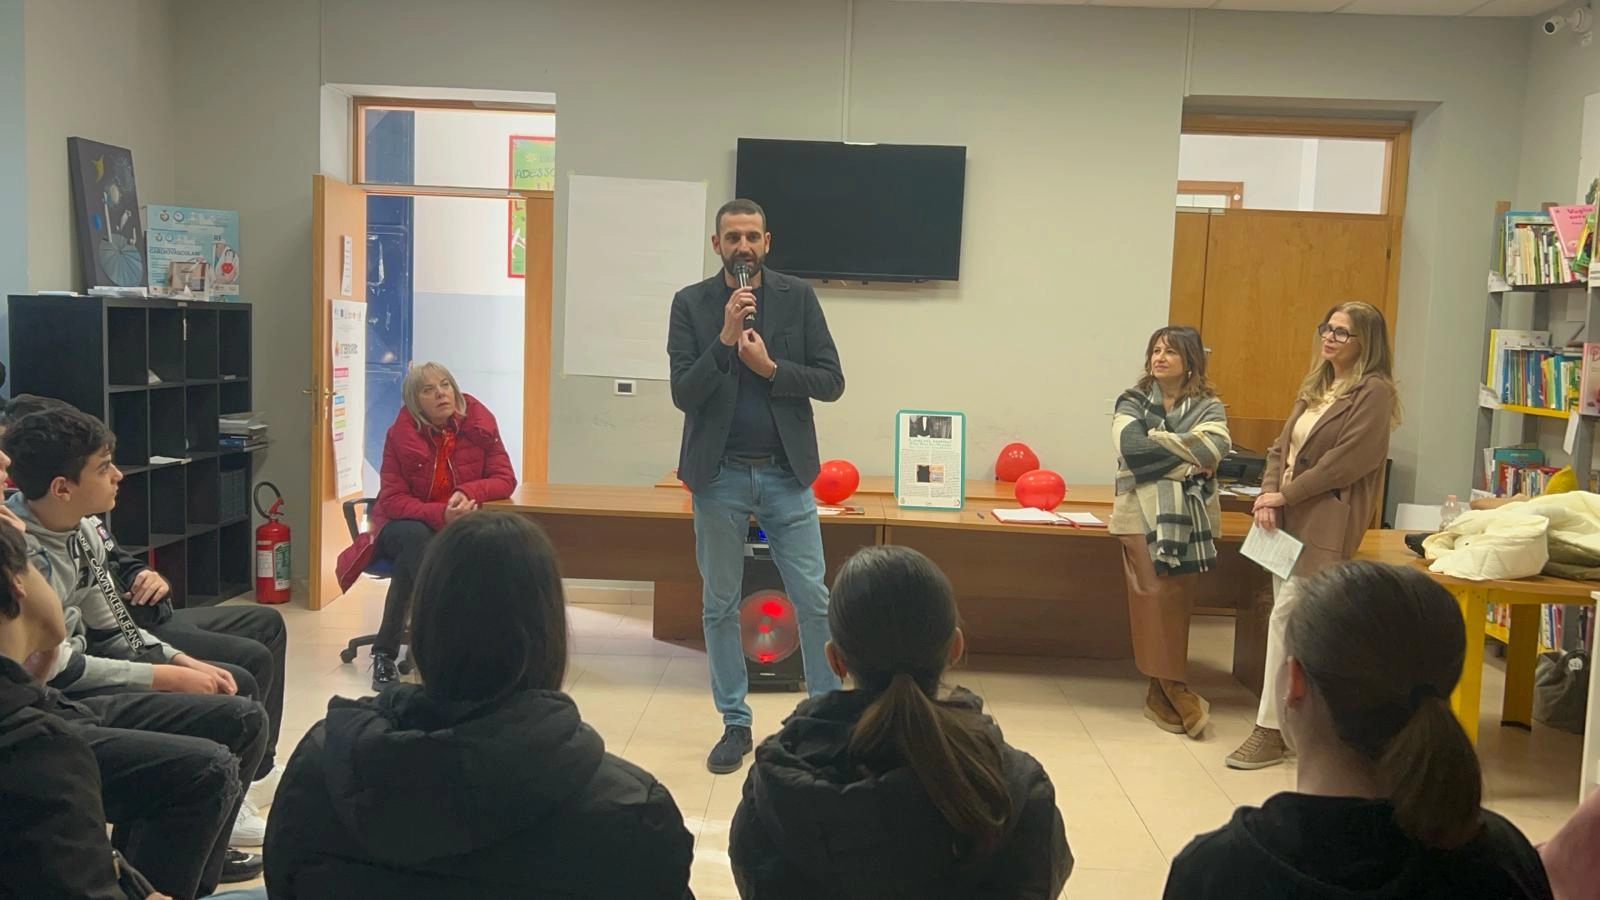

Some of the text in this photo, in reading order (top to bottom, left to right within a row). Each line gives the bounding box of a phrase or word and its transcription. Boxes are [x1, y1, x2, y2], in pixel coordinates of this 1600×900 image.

[90, 558, 111, 592] CALVIN
[106, 592, 125, 620] KLEIN
[121, 616, 142, 649] JEANS
